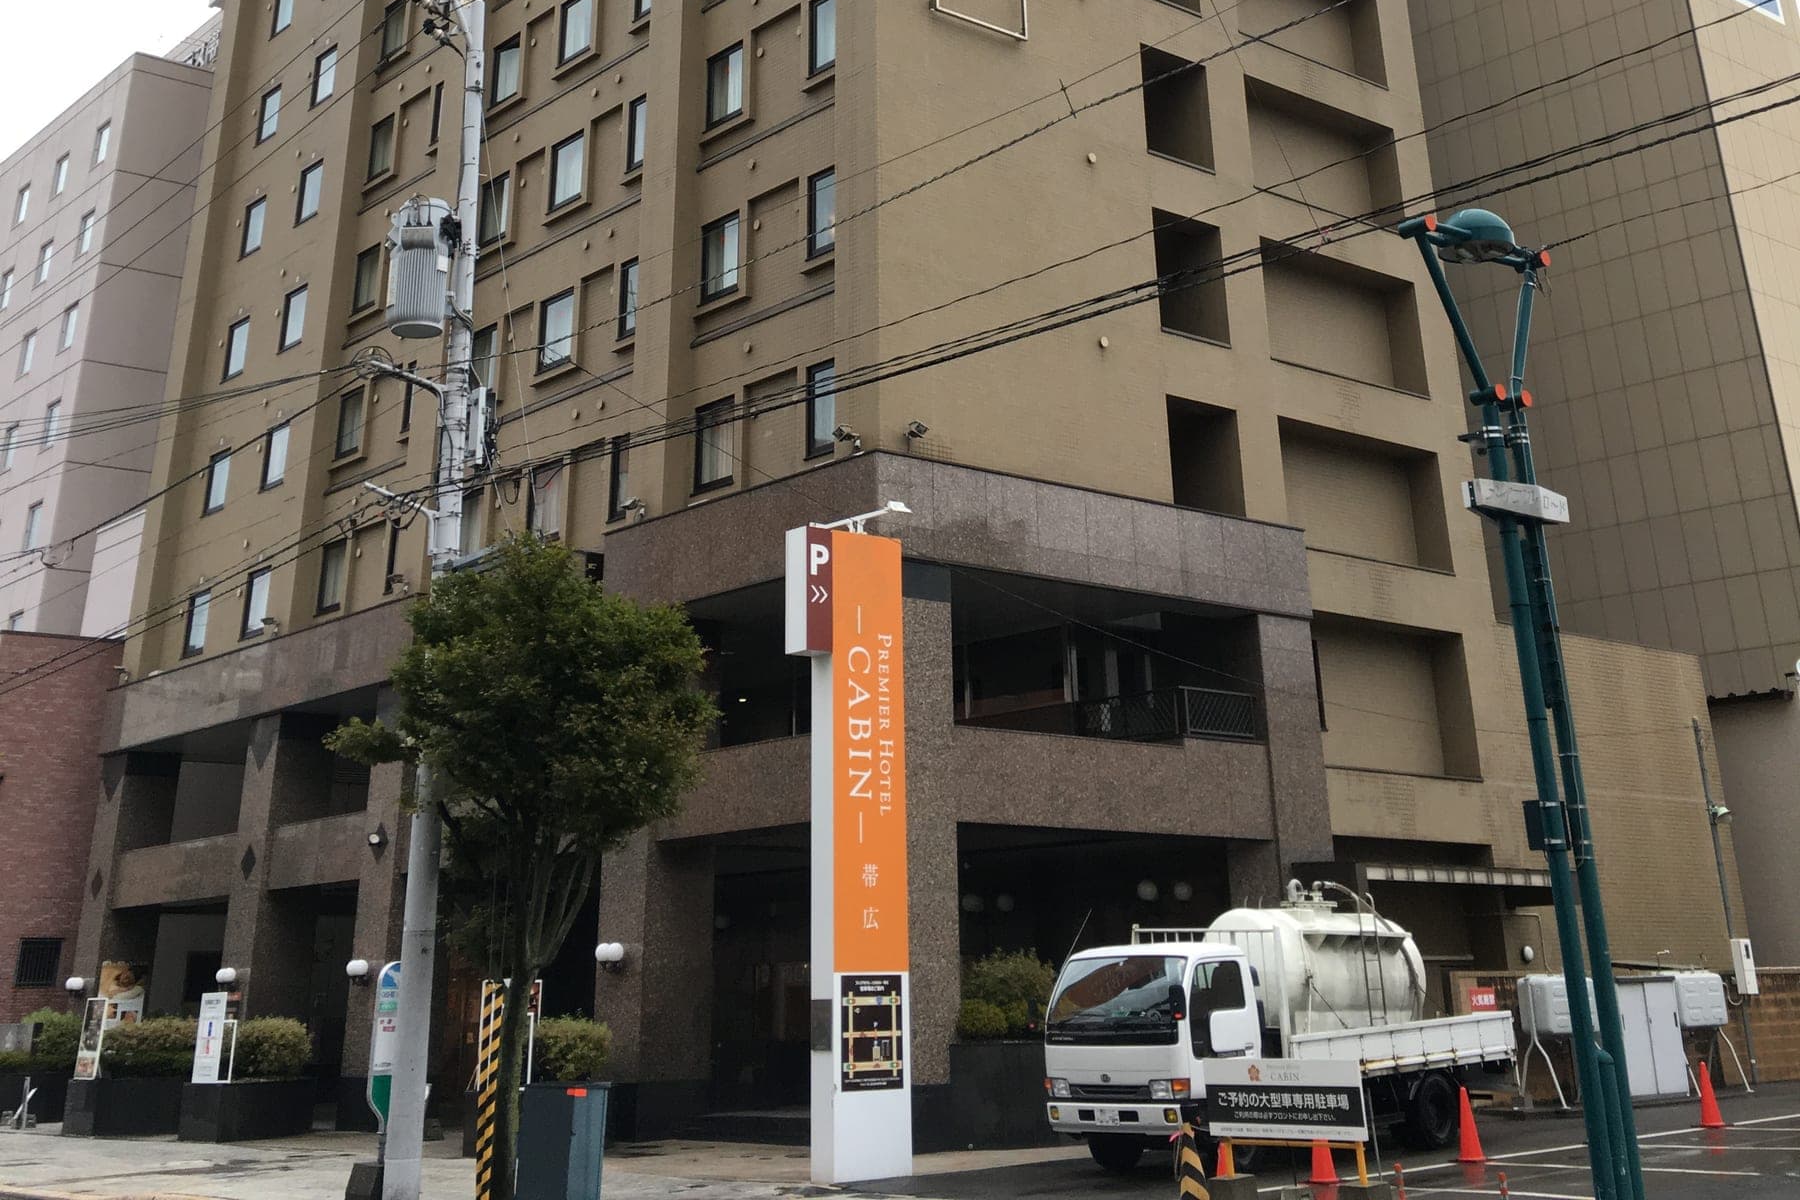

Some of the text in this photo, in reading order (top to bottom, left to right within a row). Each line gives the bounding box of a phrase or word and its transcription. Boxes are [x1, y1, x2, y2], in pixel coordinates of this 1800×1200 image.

[810, 543, 830, 576] P
[847, 645, 873, 801] CABIN
[877, 632, 894, 817] PREMIER HOTEL
[1217, 1091, 1350, 1111] ご予約の大型車専用駐車場
